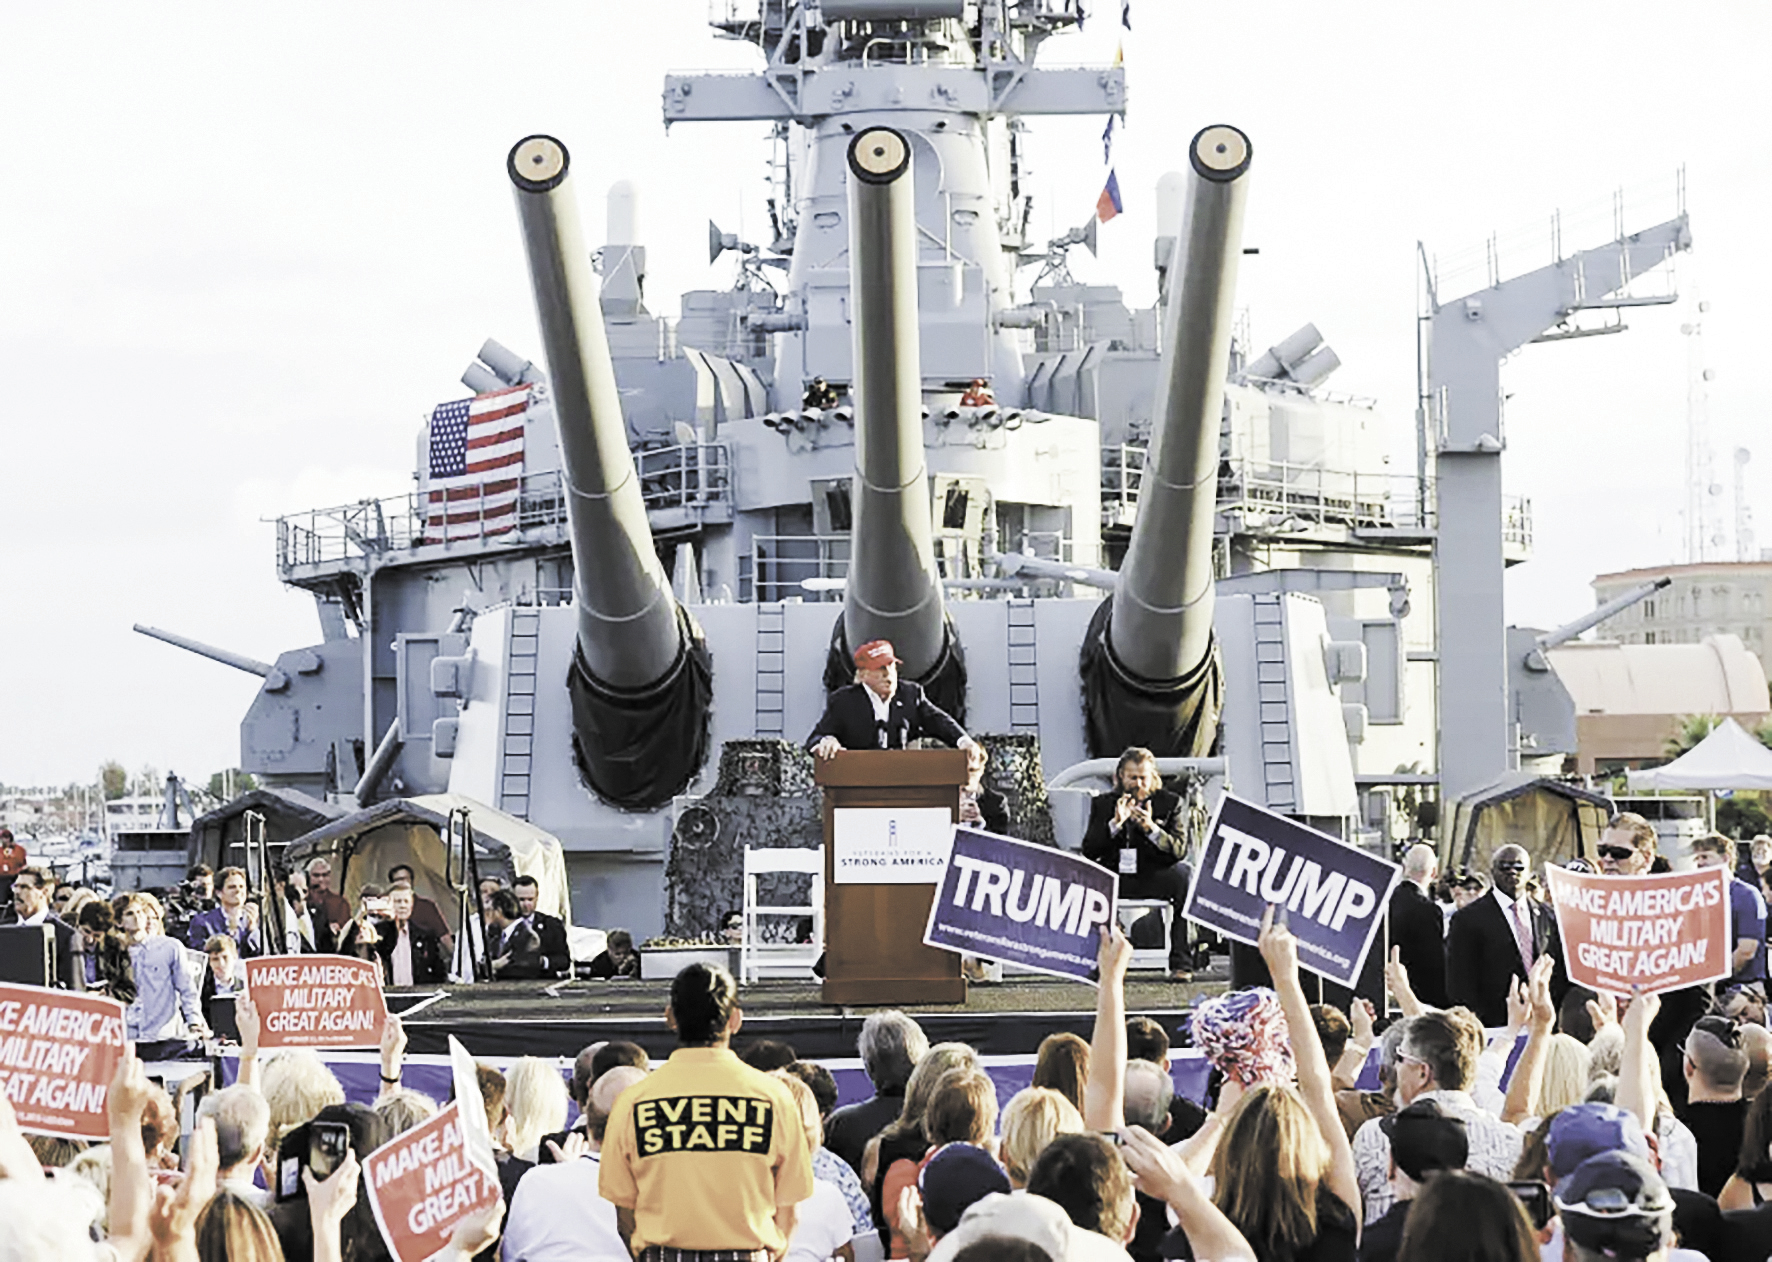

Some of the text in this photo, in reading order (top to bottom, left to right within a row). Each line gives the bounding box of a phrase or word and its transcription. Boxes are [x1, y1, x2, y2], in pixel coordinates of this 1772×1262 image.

[841, 858, 944, 867] STRONG AMERICA
[1212, 823, 1376, 932] TRUMP
[953, 854, 1110, 938] TRUMP
[1556, 879, 1720, 916] MAKE AMERICA'S
[1590, 915, 1684, 947] MILITARY
[1578, 938, 1708, 976] GREAT AGAIN!
[251, 965, 376, 988] MAKE AMERICA'S
[282, 987, 355, 1009] MILITARY
[17, 1004, 122, 1047] AMERICA'S
[266, 1009, 374, 1032] GREAT AGAIN!
[29, 1076, 107, 1114] AGAIN!
[637, 1098, 771, 1128] EVENT
[644, 1124, 764, 1153] STAFF
[375, 1131, 441, 1189] MAKE
[408, 1173, 480, 1235] GREAT
